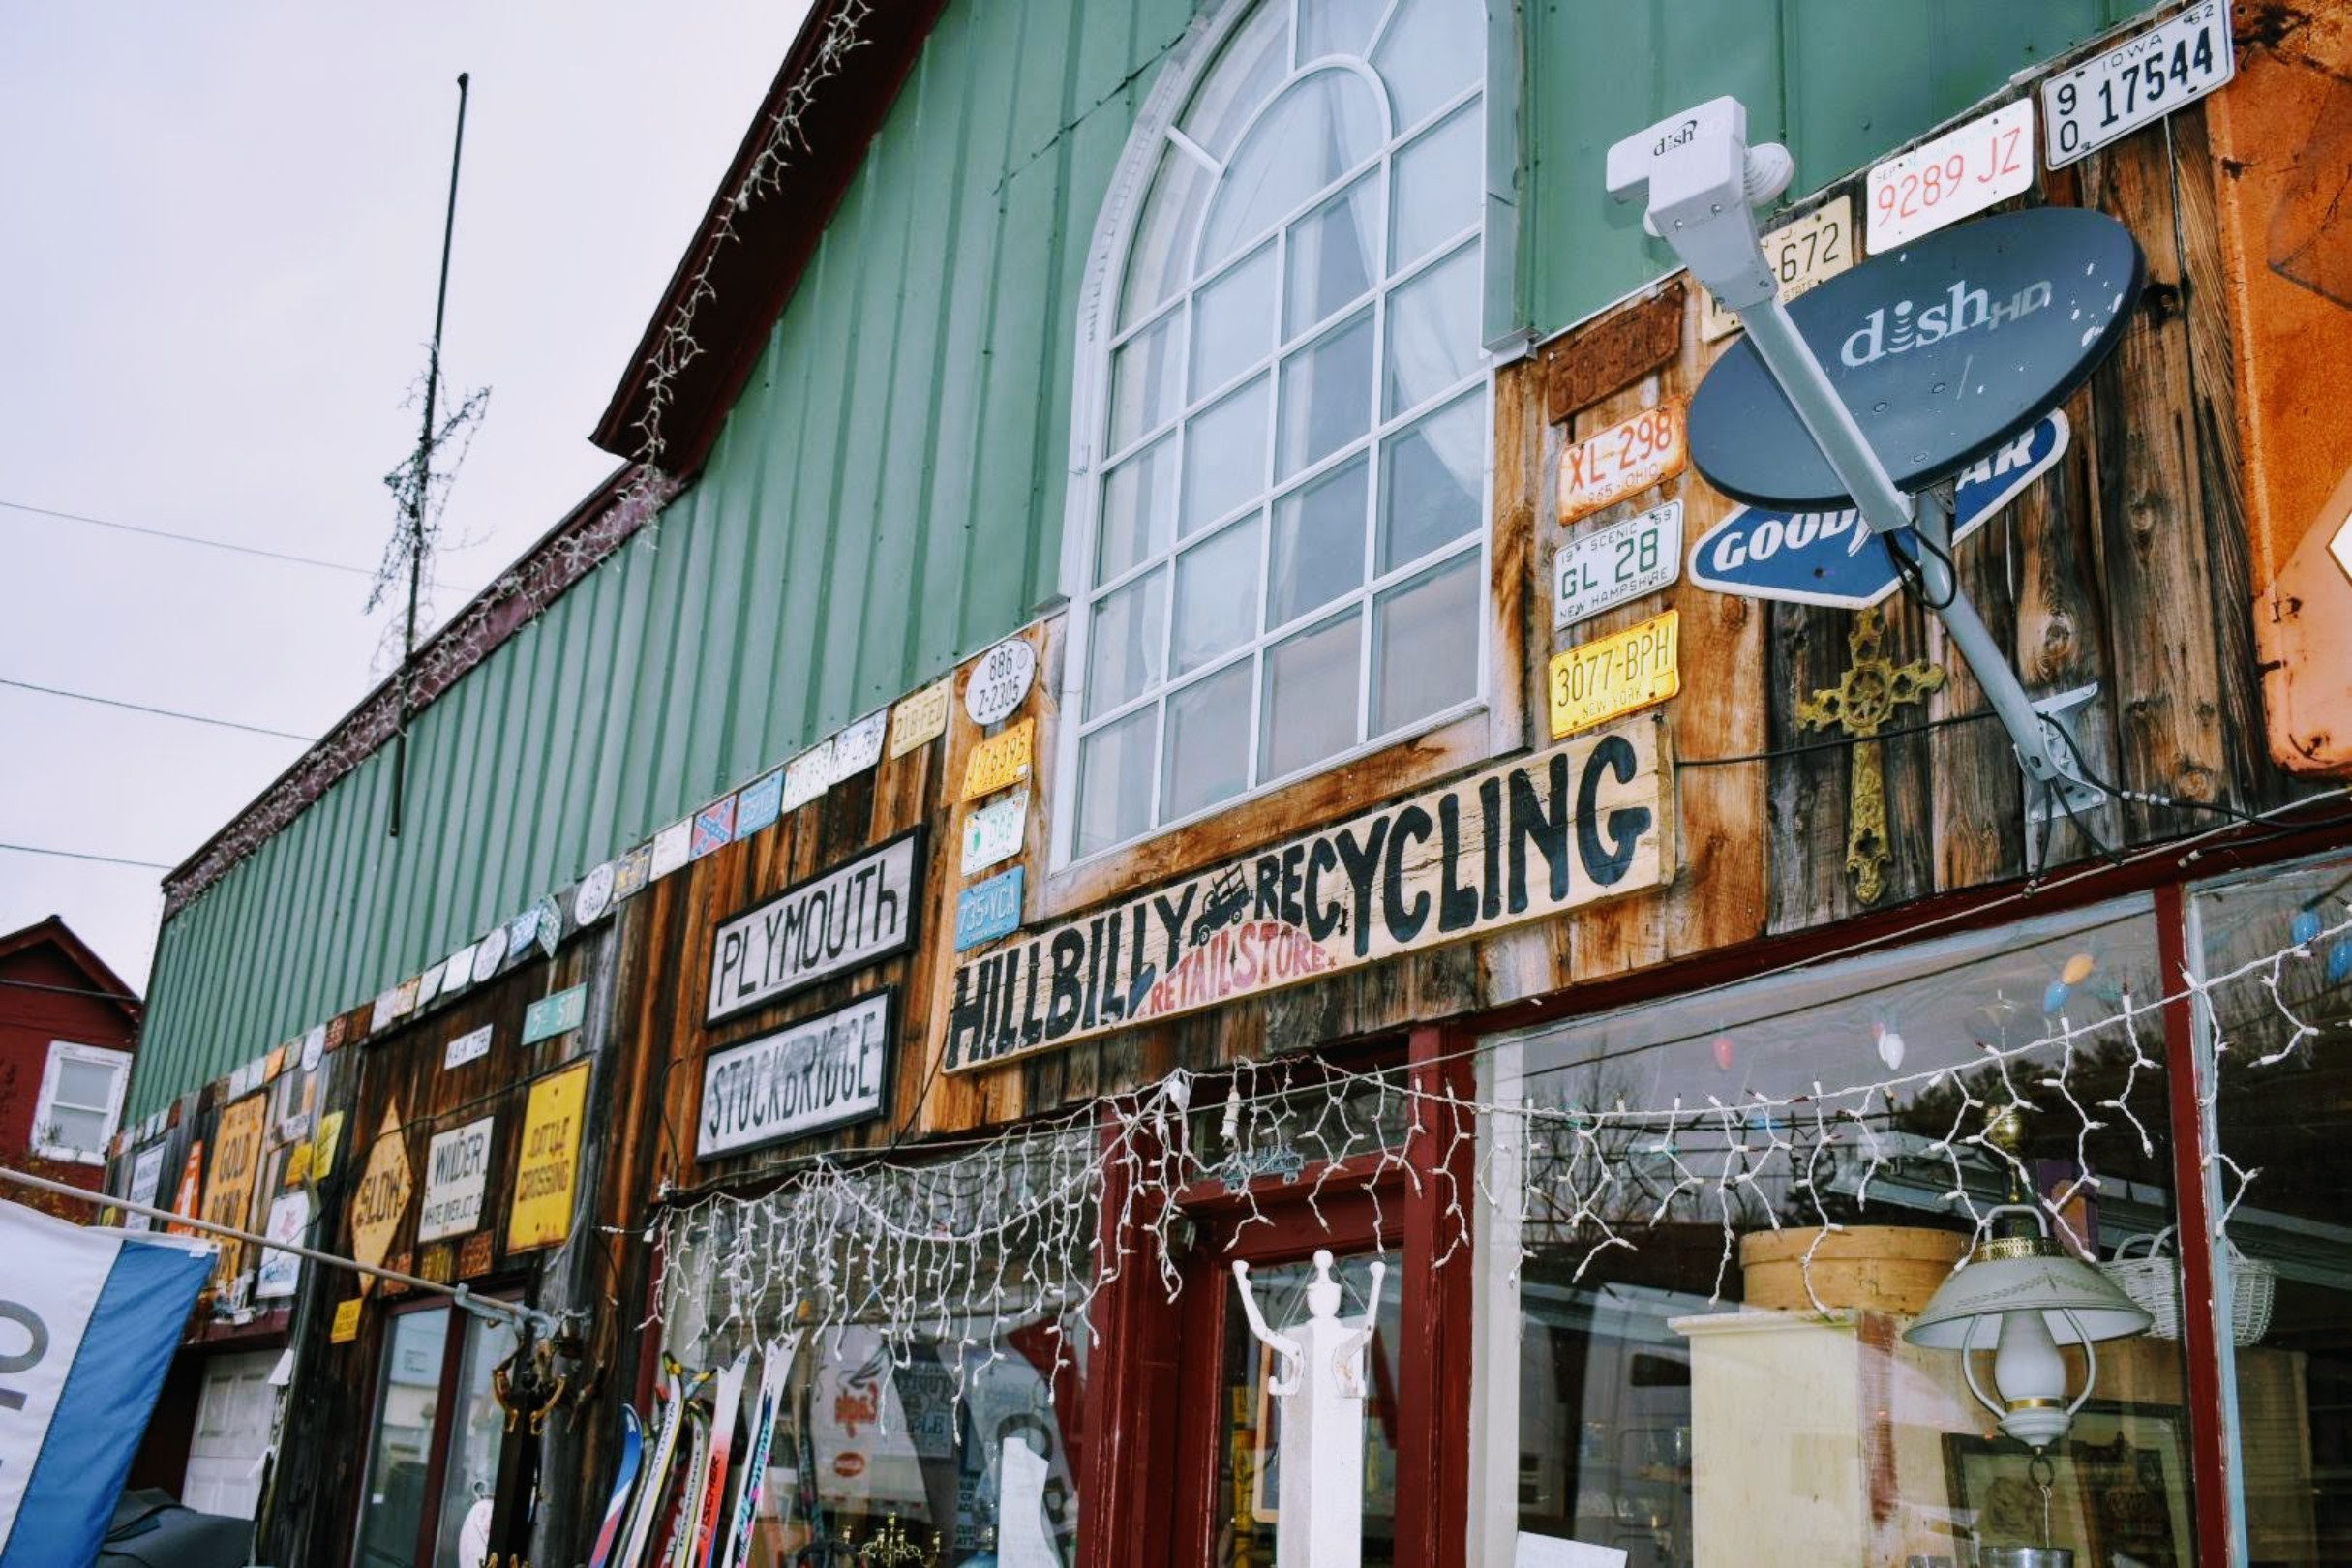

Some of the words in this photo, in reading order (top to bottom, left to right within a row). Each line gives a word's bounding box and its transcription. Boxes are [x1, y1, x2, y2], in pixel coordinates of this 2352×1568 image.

[2098, 26, 2213, 128] 17544
[2102, 34, 2163, 71] IOWA
[1878, 154, 1964, 228] 9289
[1977, 127, 2021, 184] JZ
[1569, 410, 1672, 494] XL-298
[1561, 562, 1598, 600] GL
[1615, 528, 1659, 583] 28
[1590, 523, 1638, 551] SCENIC
[1559, 601, 1585, 618] NEW
[1590, 567, 1669, 606] HAMPSHIRE
[989, 648, 1014, 682] 886
[1558, 624, 1670, 707] 3077-BPH
[717, 859, 899, 1007] PLYMOUTH
[945, 883, 1198, 1070] HILLBILLY
[1256, 735, 1652, 958] RECYCLING
[1149, 929, 1231, 1016] RETAIL
[1232, 922, 1327, 989] STORE
[709, 1011, 877, 1139] STOCKBRIDGE
